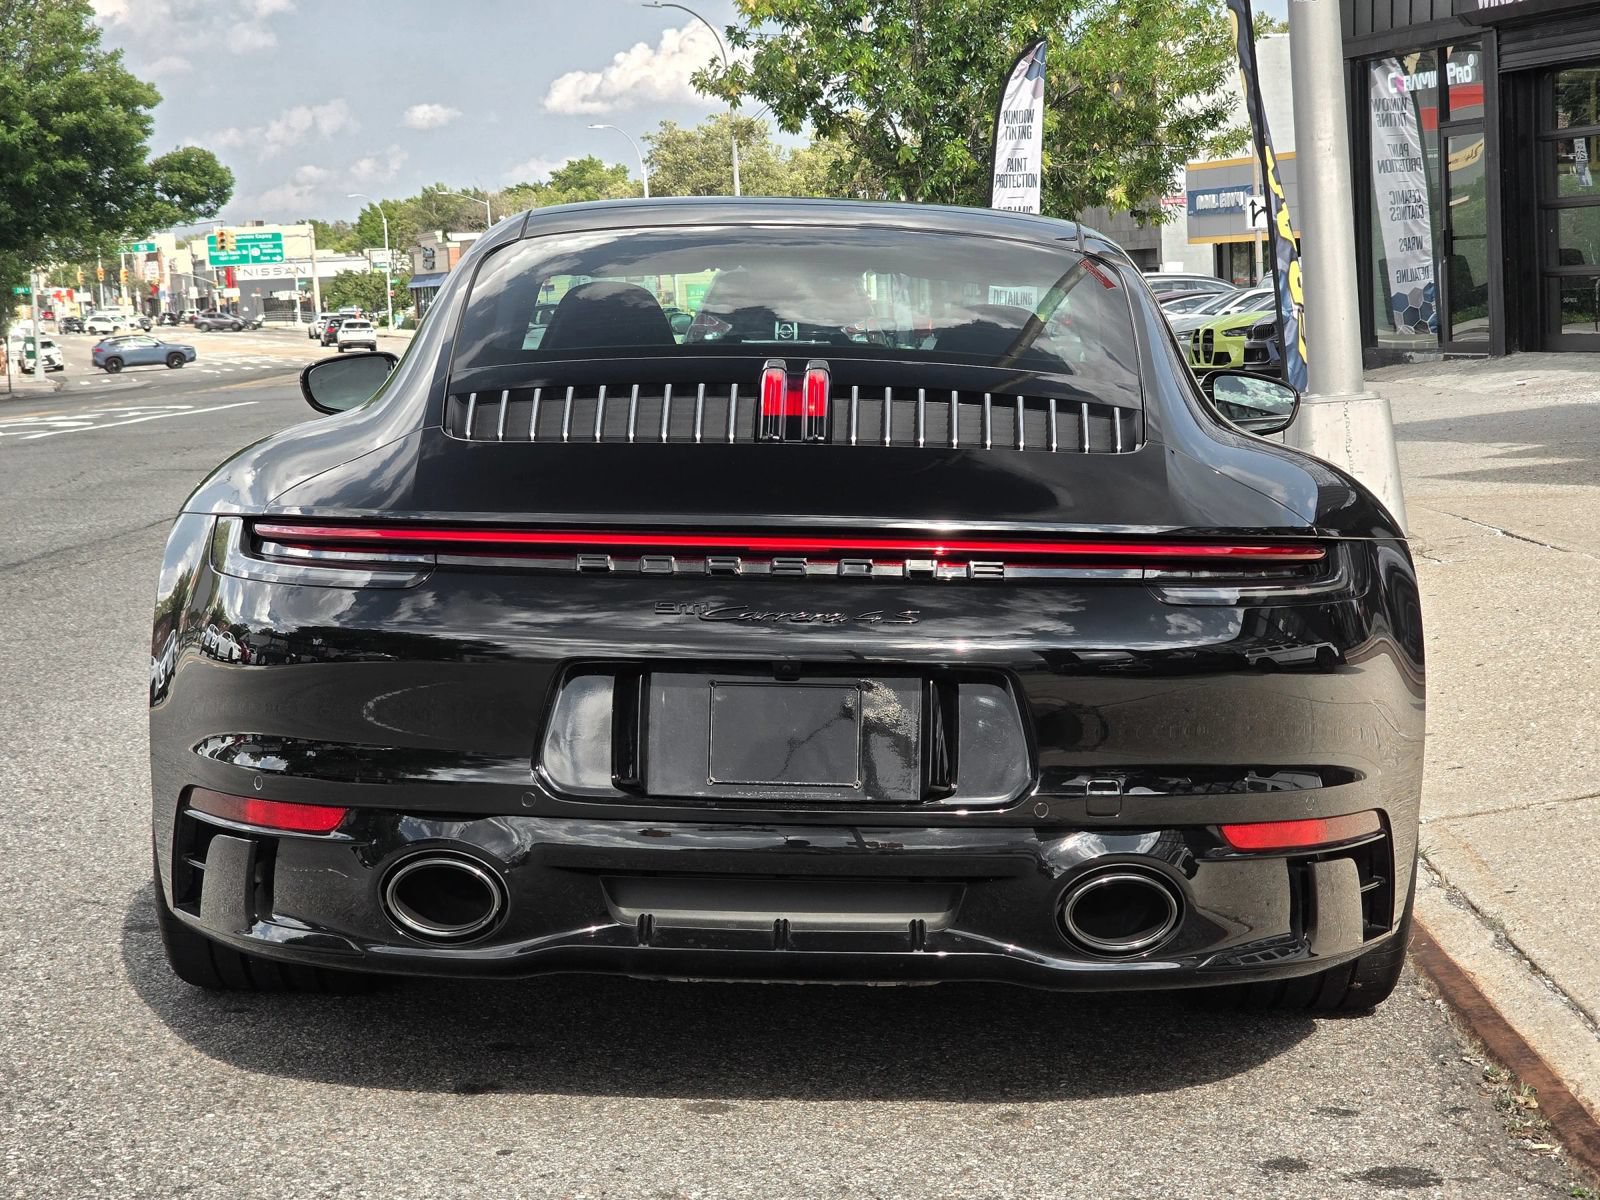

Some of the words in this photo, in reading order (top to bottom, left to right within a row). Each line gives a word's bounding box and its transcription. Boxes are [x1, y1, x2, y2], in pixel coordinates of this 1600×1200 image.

[1388, 70, 1437, 94] CRAMI
[1003, 109, 1035, 125] WINDOW
[1006, 157, 1028, 173] PAINT
[995, 172, 1038, 189] PROTECTION
[243, 266, 307, 277] NISSAN
[993, 289, 1033, 306] DETAILING
[575, 553, 1006, 580] PORSCHE
[698, 605, 849, 625] Carrera
